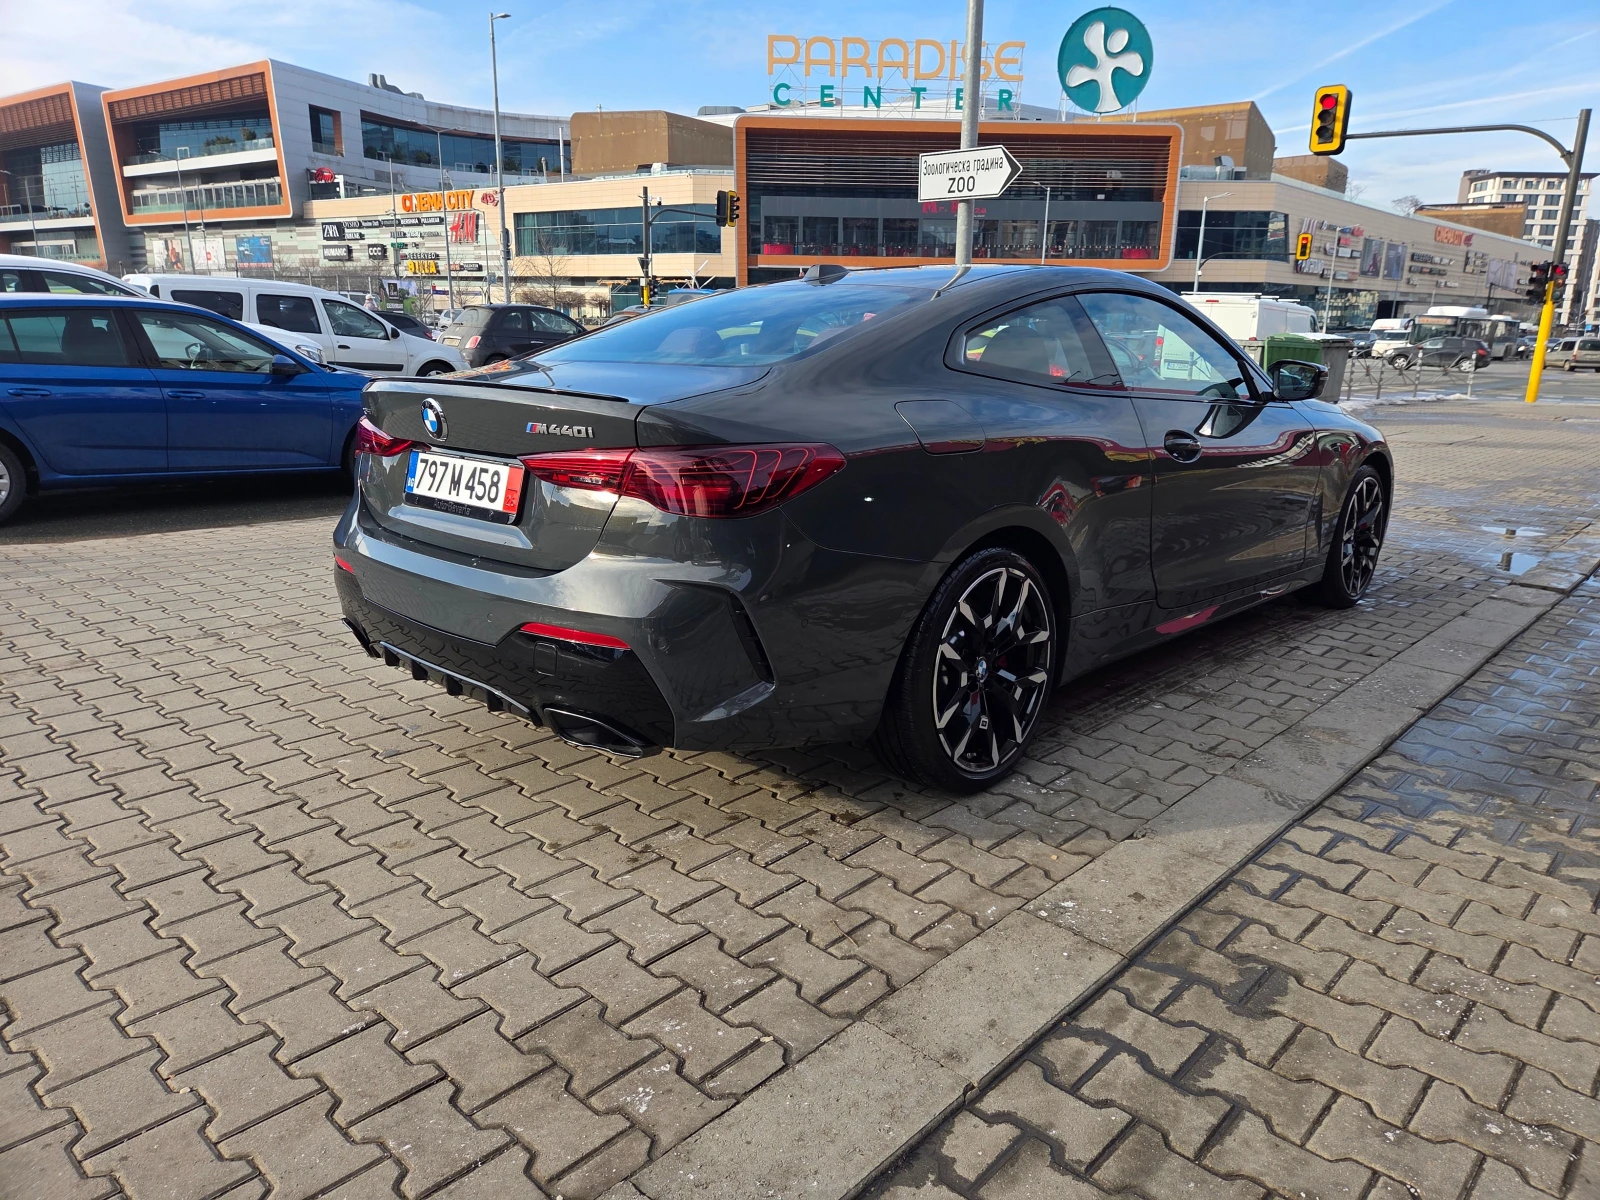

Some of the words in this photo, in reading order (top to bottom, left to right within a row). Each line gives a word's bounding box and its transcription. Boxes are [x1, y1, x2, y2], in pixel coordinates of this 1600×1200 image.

[768, 35, 1025, 81] PARADISE
[773, 83, 1013, 111] CENTER
[923, 160, 970, 176] Зоологическа
[973, 156, 1003, 175] градина
[948, 175, 976, 194] ZOO
[402, 192, 443, 212] CINEMA
[446, 190, 474, 210] CITY
[323, 224, 340, 238] ZARA
[449, 212, 476, 243] H&M
[323, 247, 347, 257] HUMANIC
[368, 246, 382, 256] CCC
[407, 252, 436, 260] RESERVED
